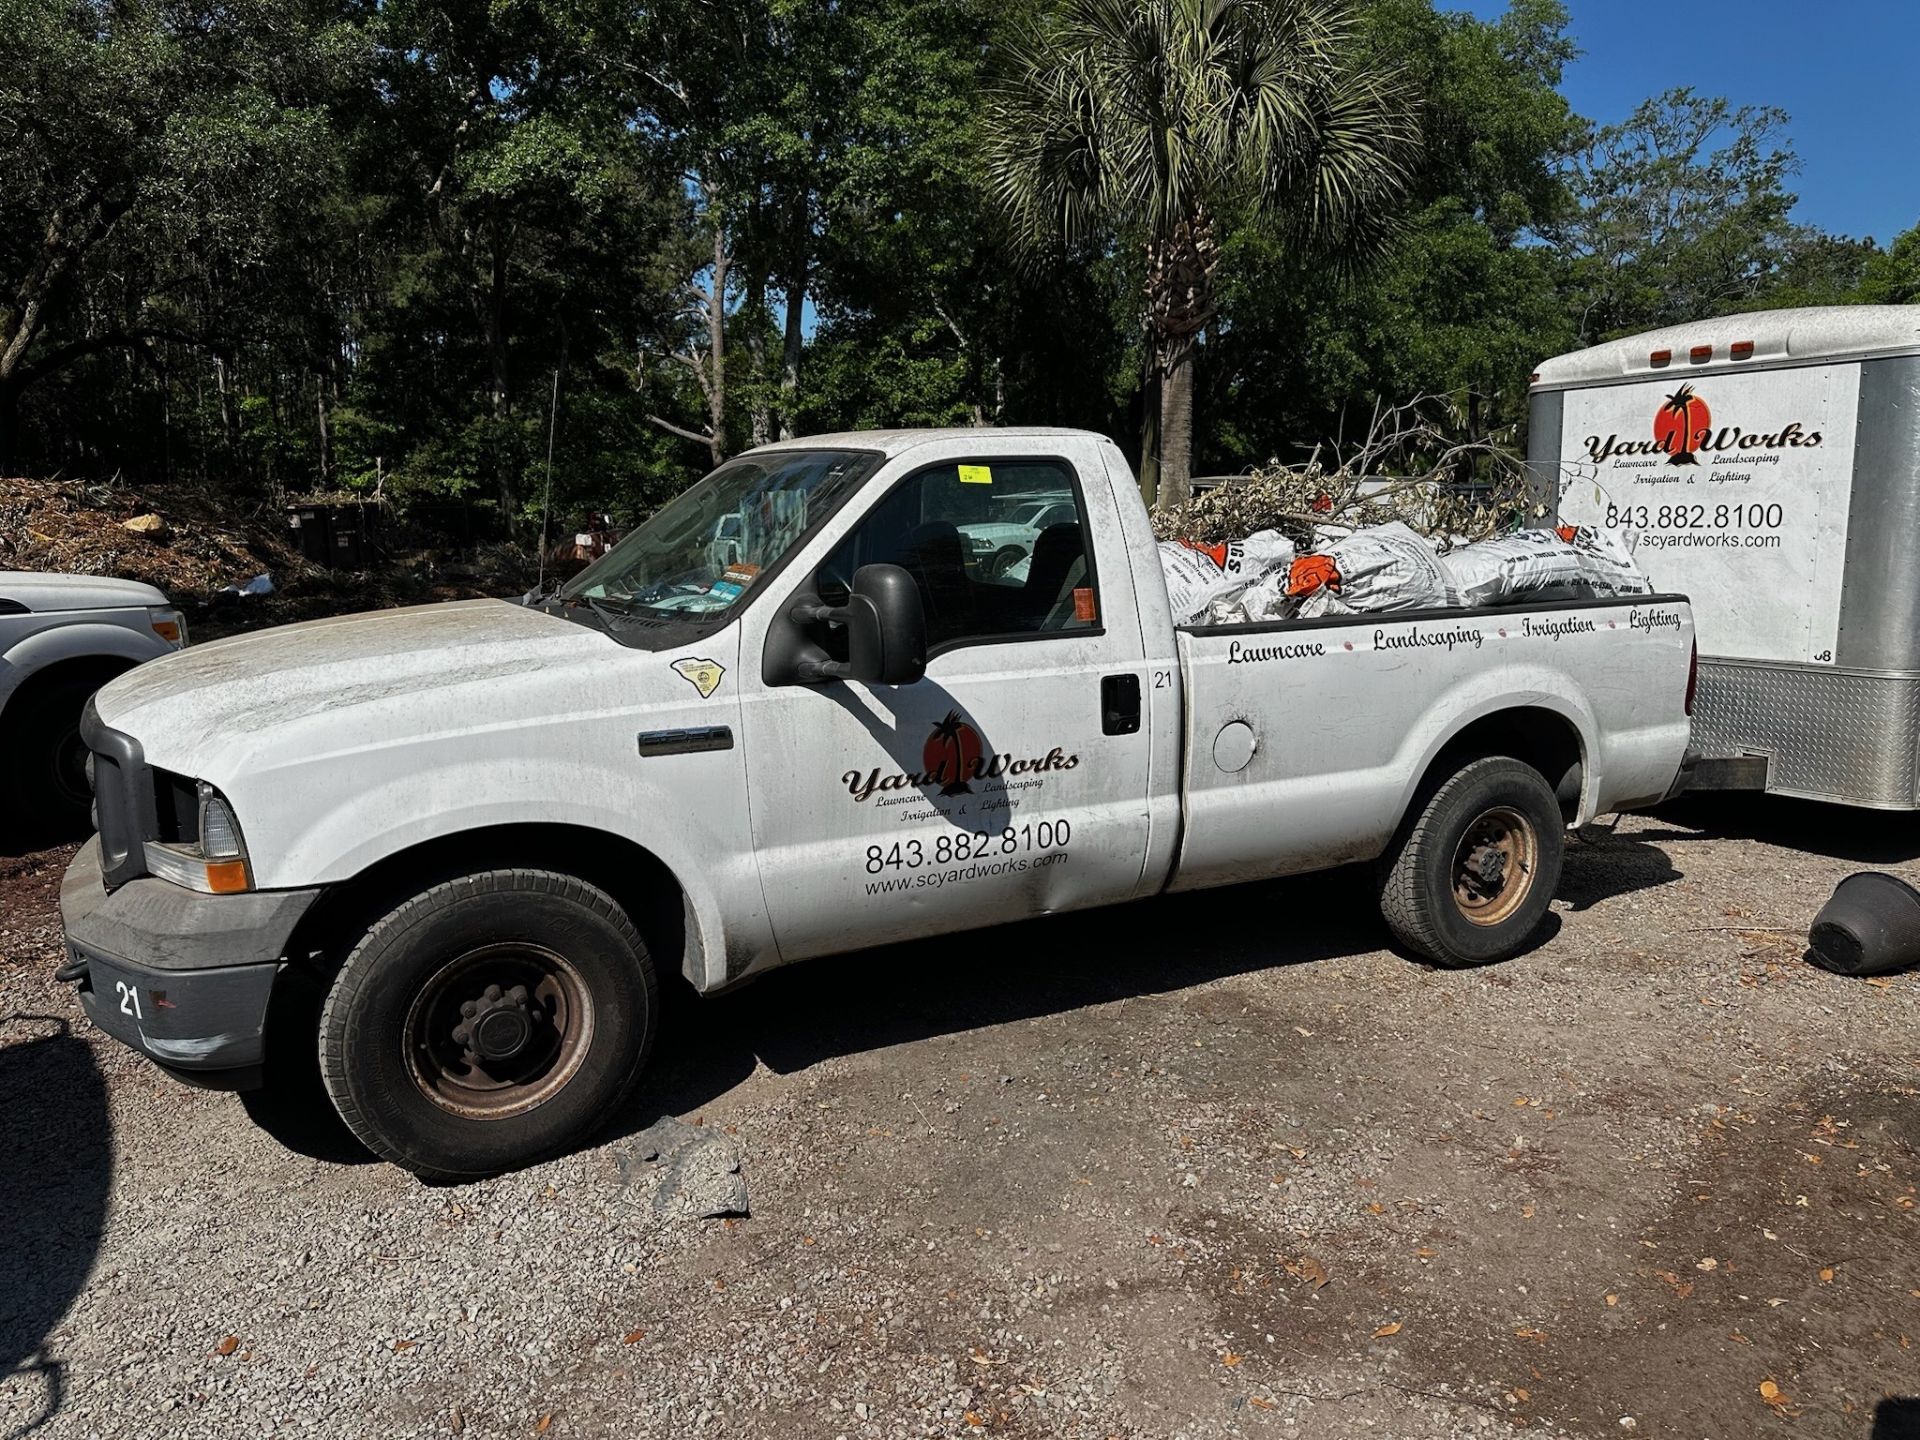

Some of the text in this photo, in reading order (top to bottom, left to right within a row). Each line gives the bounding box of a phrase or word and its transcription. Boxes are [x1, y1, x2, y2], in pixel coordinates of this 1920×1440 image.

[1584, 422, 1823, 463] Yard Works
[1612, 453, 1780, 469] Lawncare Landscaping
[1633, 471, 1751, 485] Irrigation & Lighting
[1605, 503, 1783, 529] 843.882.8100
[1227, 609, 1682, 664] Lawncare Landscaping Irrigation Lighting
[1154, 671, 1172, 689] 21
[841, 747, 1079, 802] Yard Works
[875, 778, 1043, 808] Lawncare Landscaping
[900, 796, 1020, 822] Irrigation & Lighting
[865, 819, 1071, 874] 843.882.8100
[865, 851, 1068, 896] www.scyardworks.com
[116, 981, 142, 1019] 21
